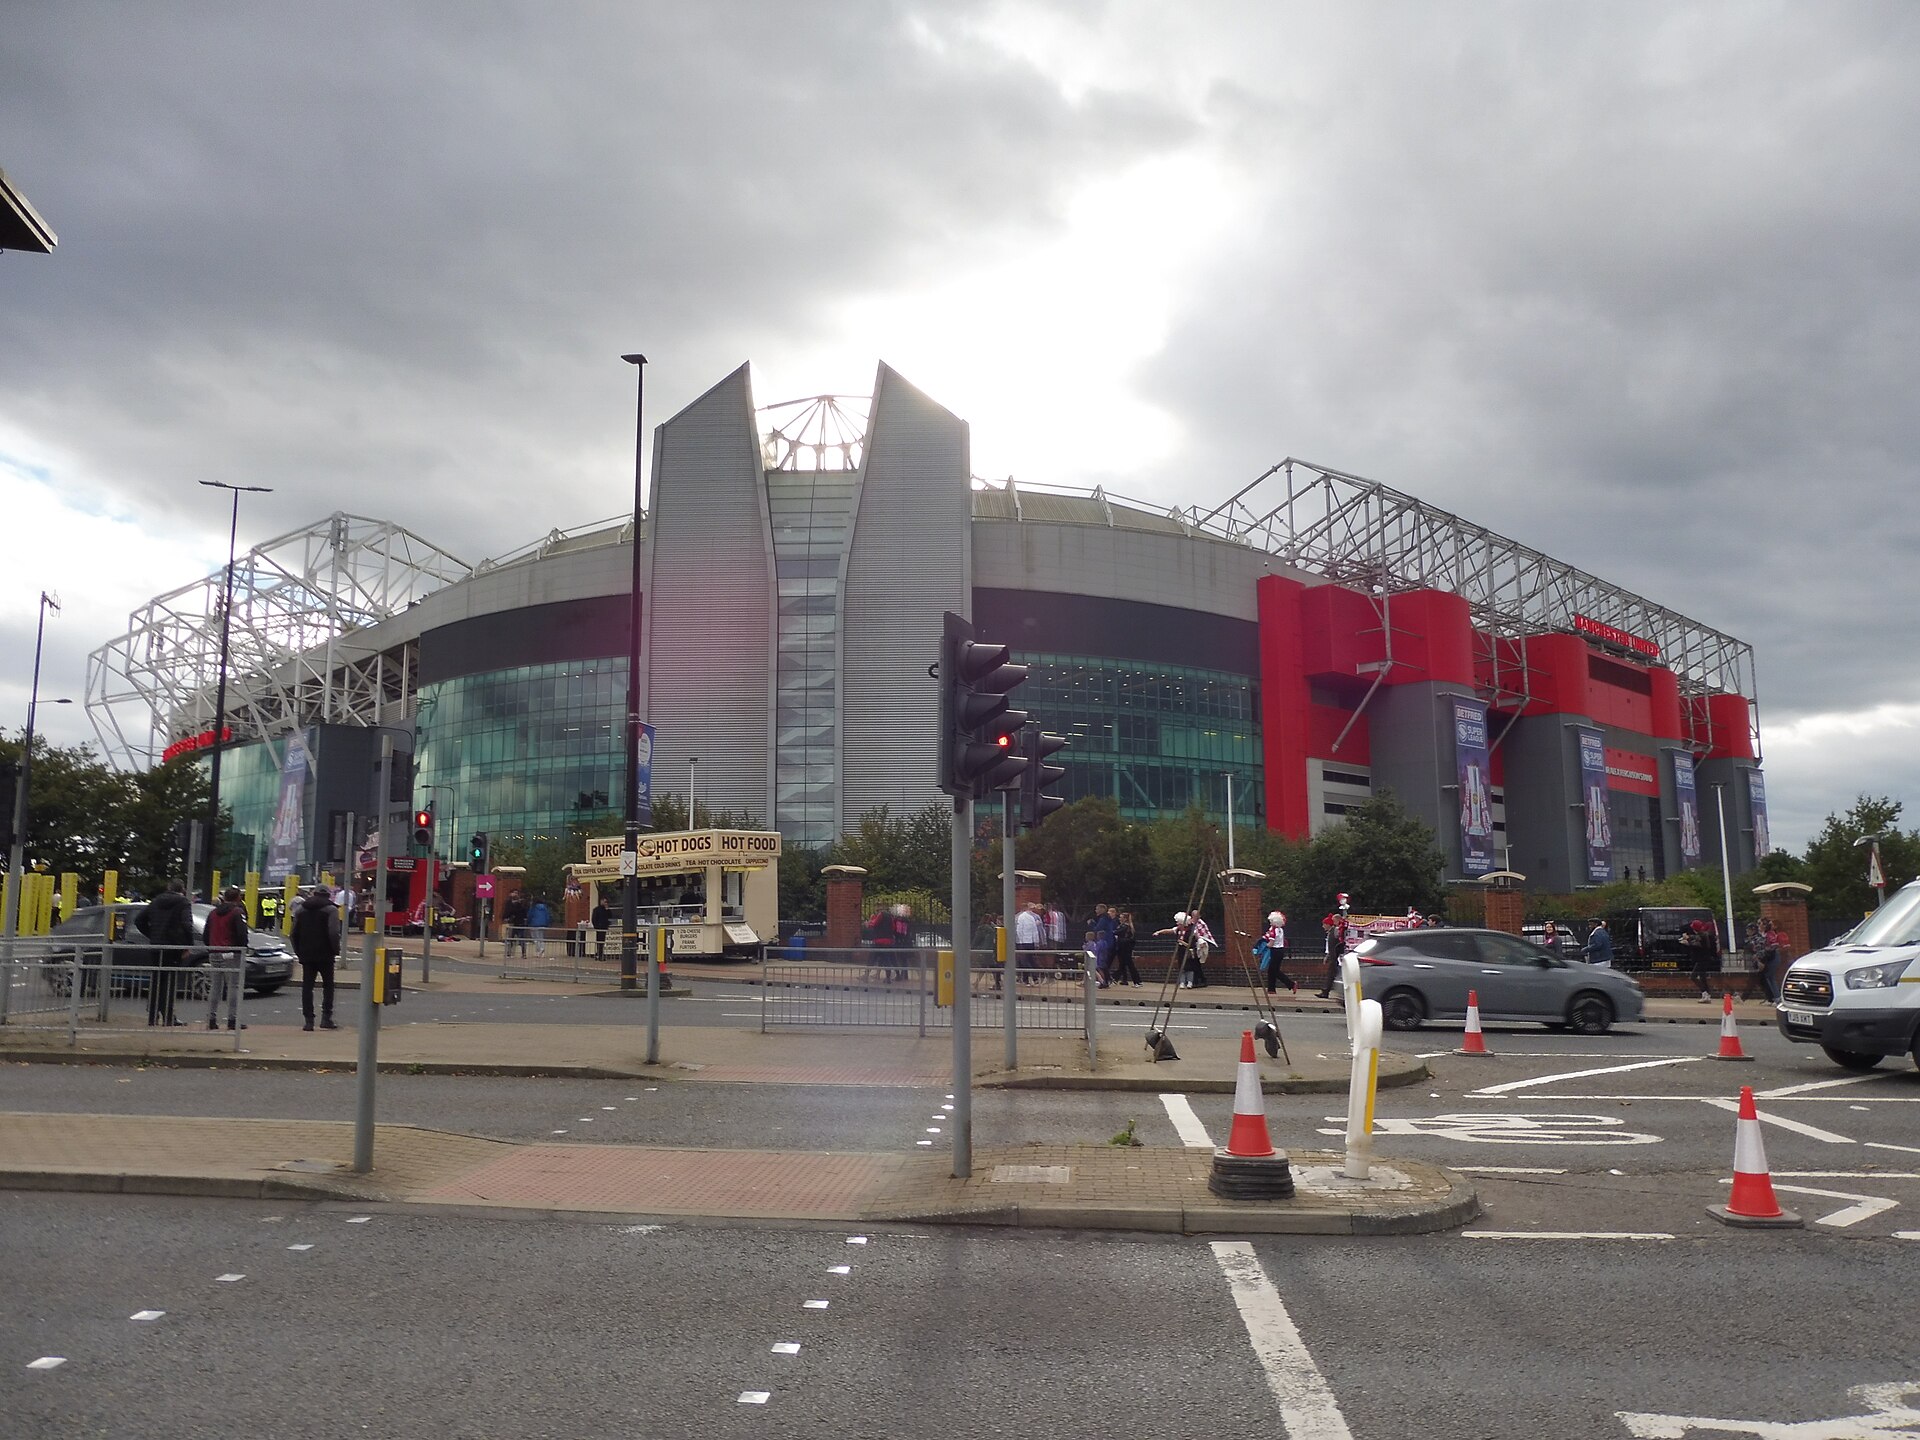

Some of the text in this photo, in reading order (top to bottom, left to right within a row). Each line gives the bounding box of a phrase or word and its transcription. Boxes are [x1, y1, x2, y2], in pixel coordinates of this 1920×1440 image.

[1457, 708, 1482, 721] BETFRED
[1467, 725, 1483, 735] SUPER
[1467, 733, 1484, 743] LEAGUE
[591, 836, 711, 858] BURGE HOT DOGS
[721, 836, 776, 851] HOT FOOD
